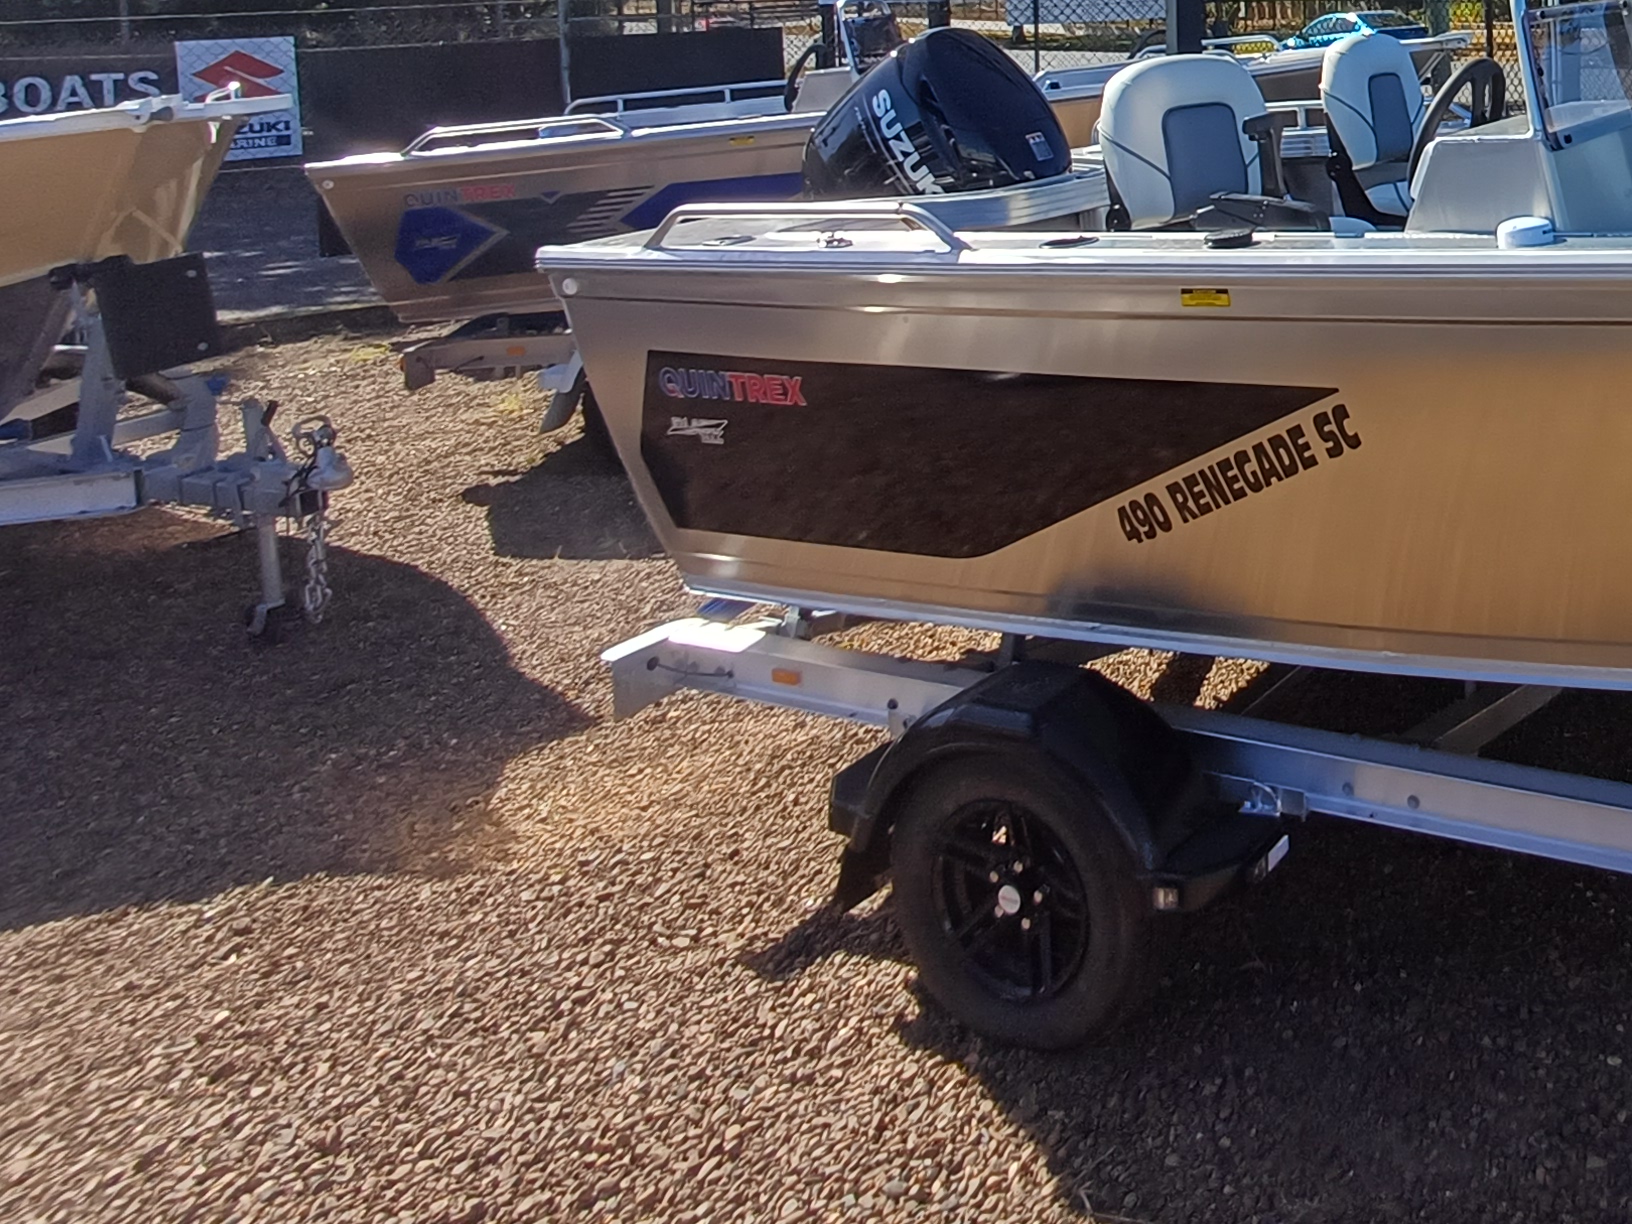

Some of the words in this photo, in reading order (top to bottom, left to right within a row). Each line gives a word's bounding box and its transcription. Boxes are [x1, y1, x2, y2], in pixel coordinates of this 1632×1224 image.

[0, 70, 161, 115] OATS
[872, 88, 945, 194] SUZUK
[403, 184, 515, 207] QUINTREX
[659, 366, 808, 407] QUINTREX
[1116, 491, 1173, 544] 490
[1165, 423, 1319, 524] RENEGADE
[1312, 403, 1363, 460] SC
